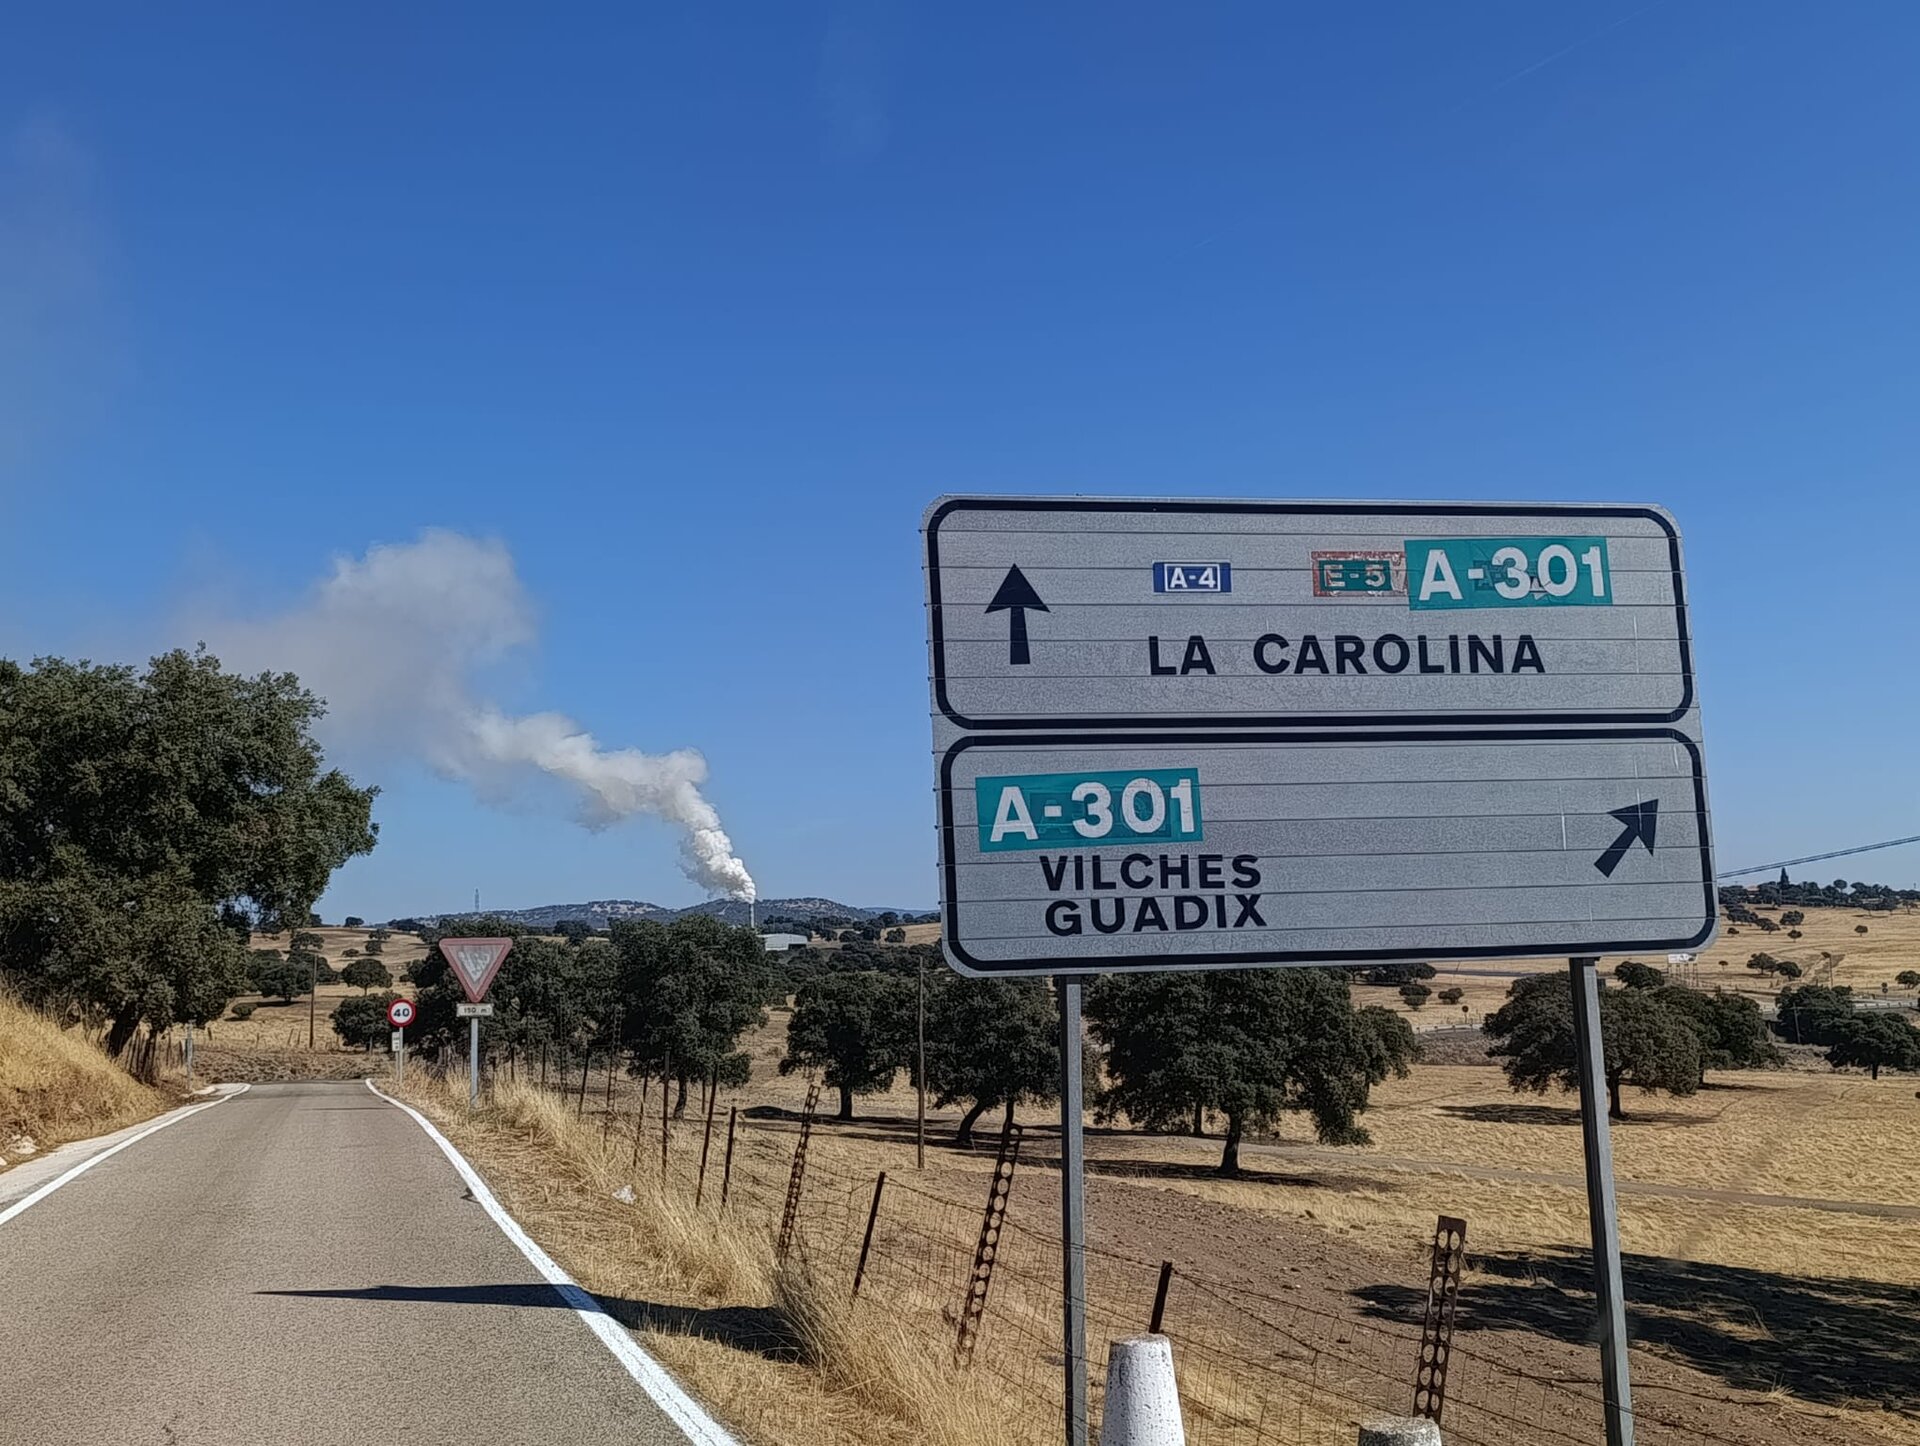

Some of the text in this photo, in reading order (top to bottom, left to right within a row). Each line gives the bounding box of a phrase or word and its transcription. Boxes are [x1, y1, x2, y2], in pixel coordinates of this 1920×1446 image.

[1170, 567, 1216, 588] A-4
[1323, 564, 1386, 587] E-5
[1419, 544, 1605, 601] A-301
[1148, 633, 1546, 675] LA CAROLINA
[989, 778, 1195, 842] A-301
[1039, 853, 1261, 891] VILCHES
[1045, 894, 1267, 936] GUADIX
[393, 1008, 410, 1017] 40
